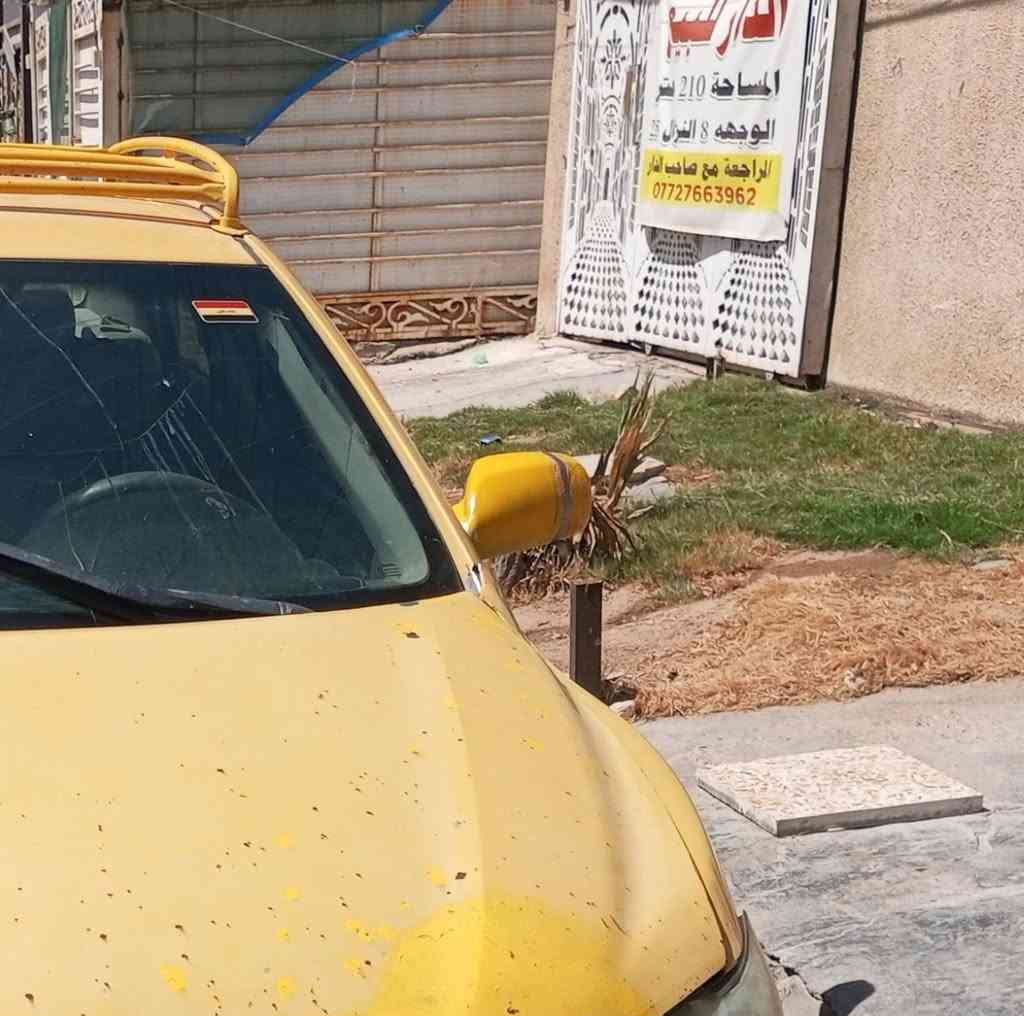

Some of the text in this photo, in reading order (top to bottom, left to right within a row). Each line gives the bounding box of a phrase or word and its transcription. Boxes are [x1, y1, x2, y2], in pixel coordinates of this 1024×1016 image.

[678, 74, 706, 98] 210
[711, 69, 780, 98] المساحة
[700, 120, 709, 139] 8
[652, 182, 757, 206] 07727663962
